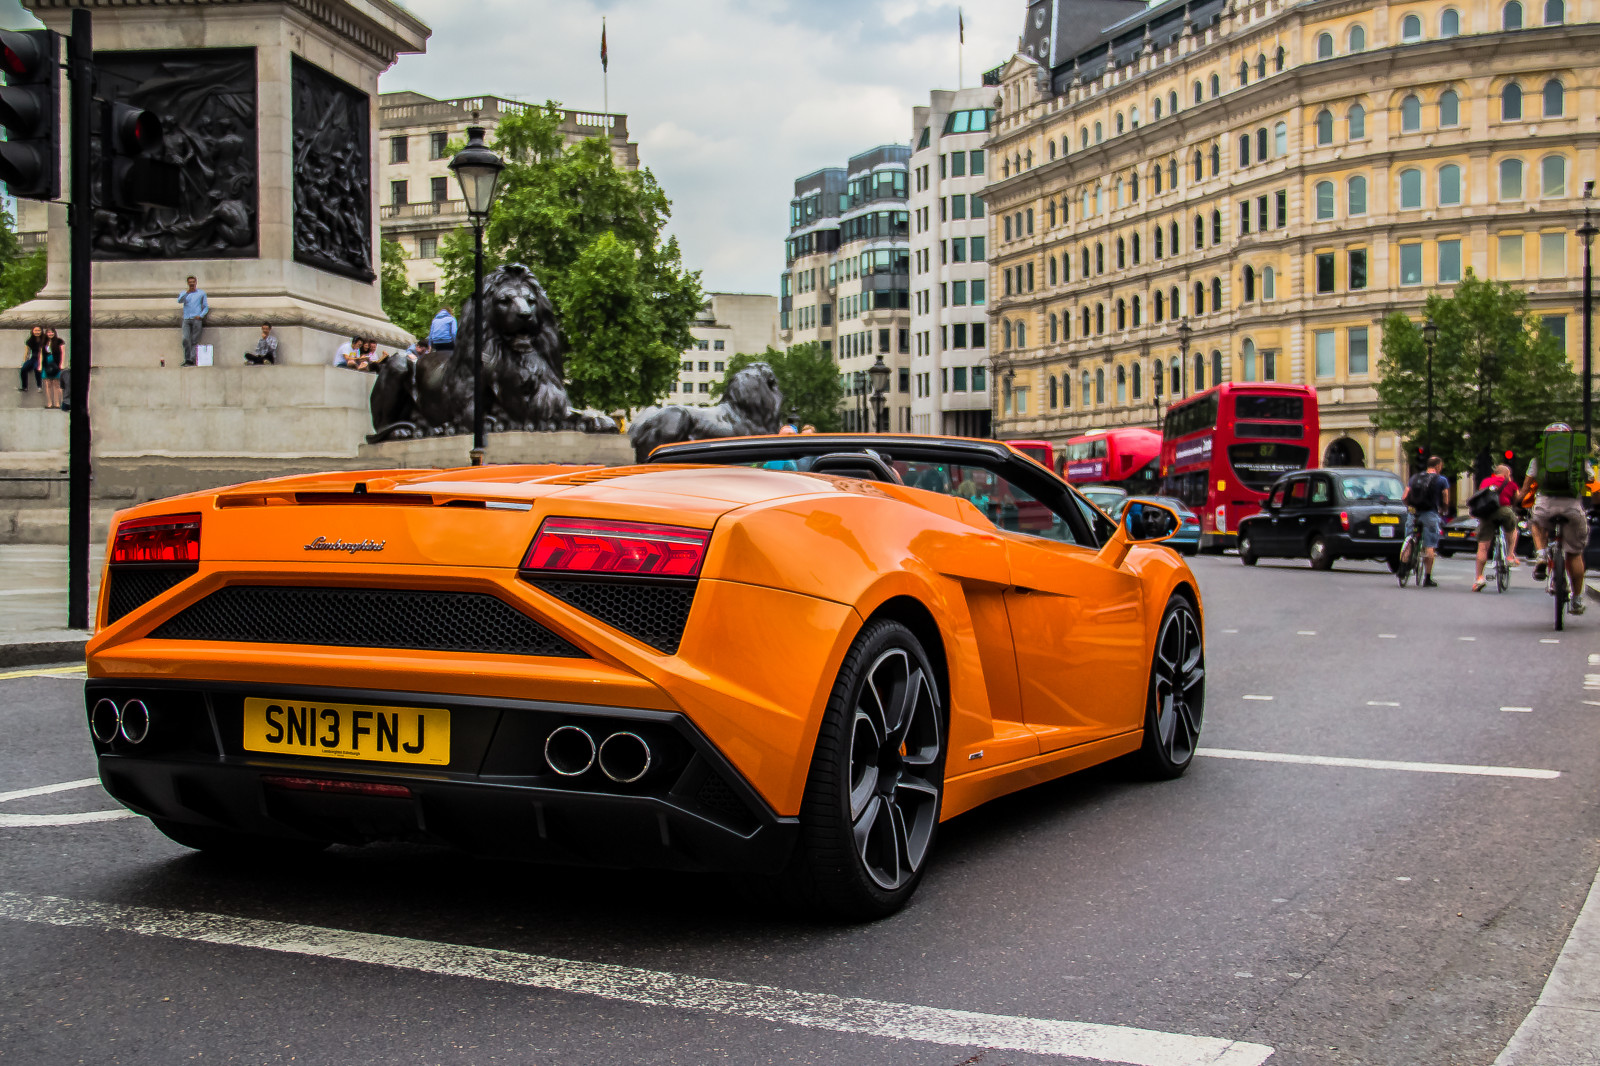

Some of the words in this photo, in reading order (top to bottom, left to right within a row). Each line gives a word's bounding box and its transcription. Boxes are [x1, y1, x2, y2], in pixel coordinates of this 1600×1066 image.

[1259, 445, 1275, 456] 87
[304, 536, 386, 554] Lamborghini
[265, 705, 340, 748] SN13
[352, 710, 425, 754] FNJ
